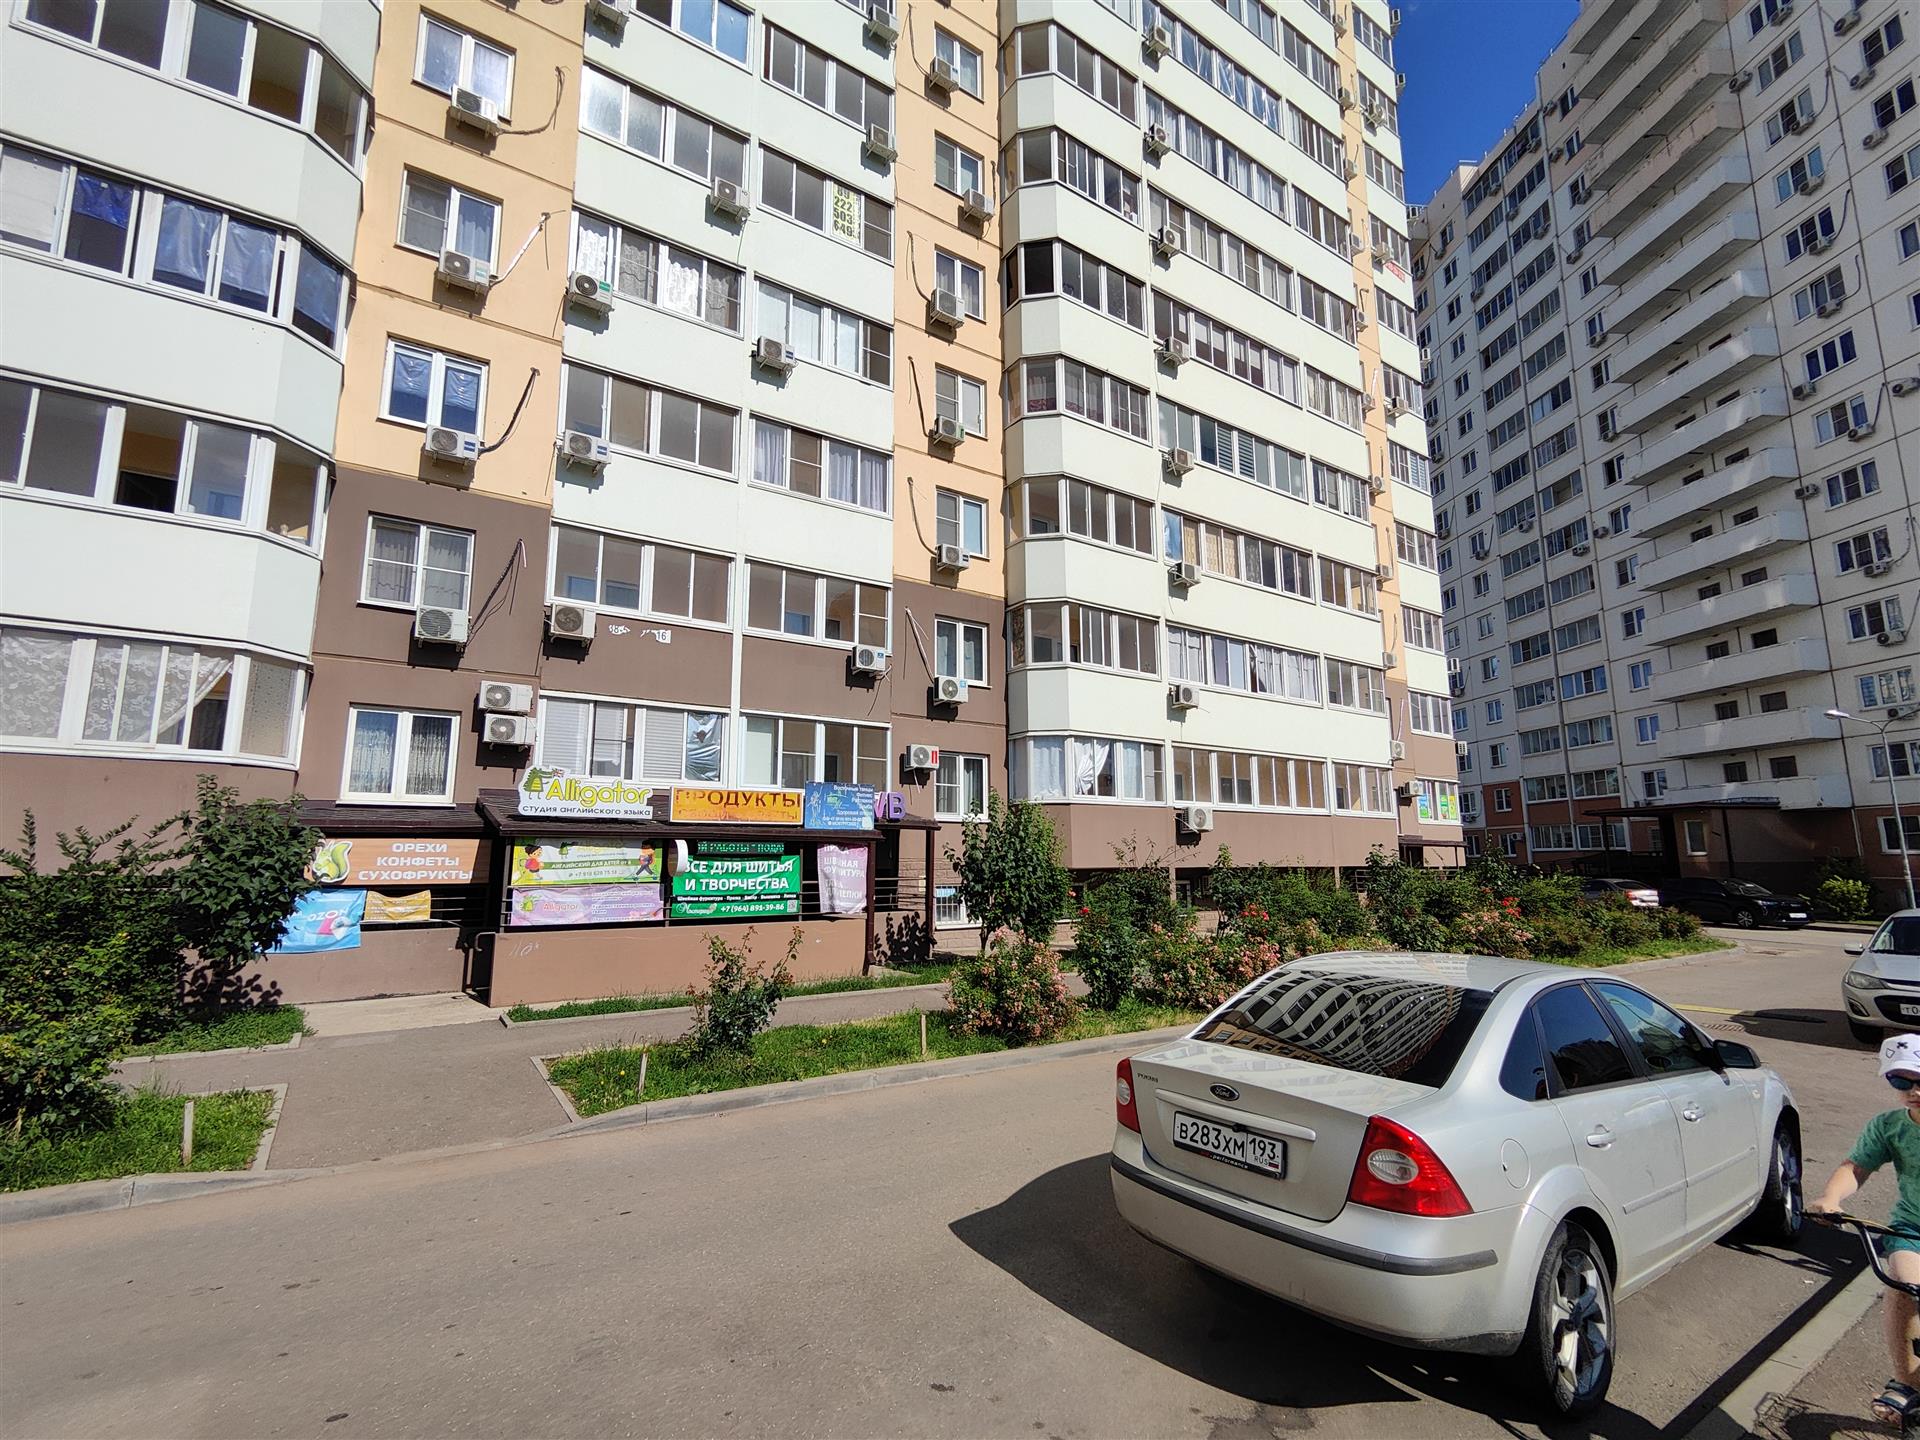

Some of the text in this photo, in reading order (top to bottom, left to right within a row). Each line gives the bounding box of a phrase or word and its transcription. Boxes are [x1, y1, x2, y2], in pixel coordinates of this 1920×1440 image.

[834, 196, 853, 213] 222
[833, 207, 853, 226] 503
[833, 219, 853, 237] 649
[657, 631, 667, 641] 16
[546, 778, 651, 807] Alligator
[522, 805, 651, 817] студия английского языка
[391, 843, 448, 853] ОРЕХИ
[376, 856, 460, 867] КОНФЕТЫ
[551, 861, 591, 869] АНГЛИЙСКИЙ
[710, 861, 742, 875] ДЛЯ
[745, 860, 793, 873] ШИТЬЯ
[824, 857, 859, 868] ШВНАЯ
[358, 869, 473, 881] СУХОФРУКТЫ
[824, 865, 865, 878] ФУИТУРА
[684, 877, 790, 891] И ТВОРЧЕСТВА
[730, 904, 749, 913] (964)
[750, 903, 785, 912] 891-39-86
[1213, 1087, 1231, 1099] Ford
[1179, 1121, 1277, 1161] В283ХМ 193
[1254, 1155, 1269, 1166] RUS
